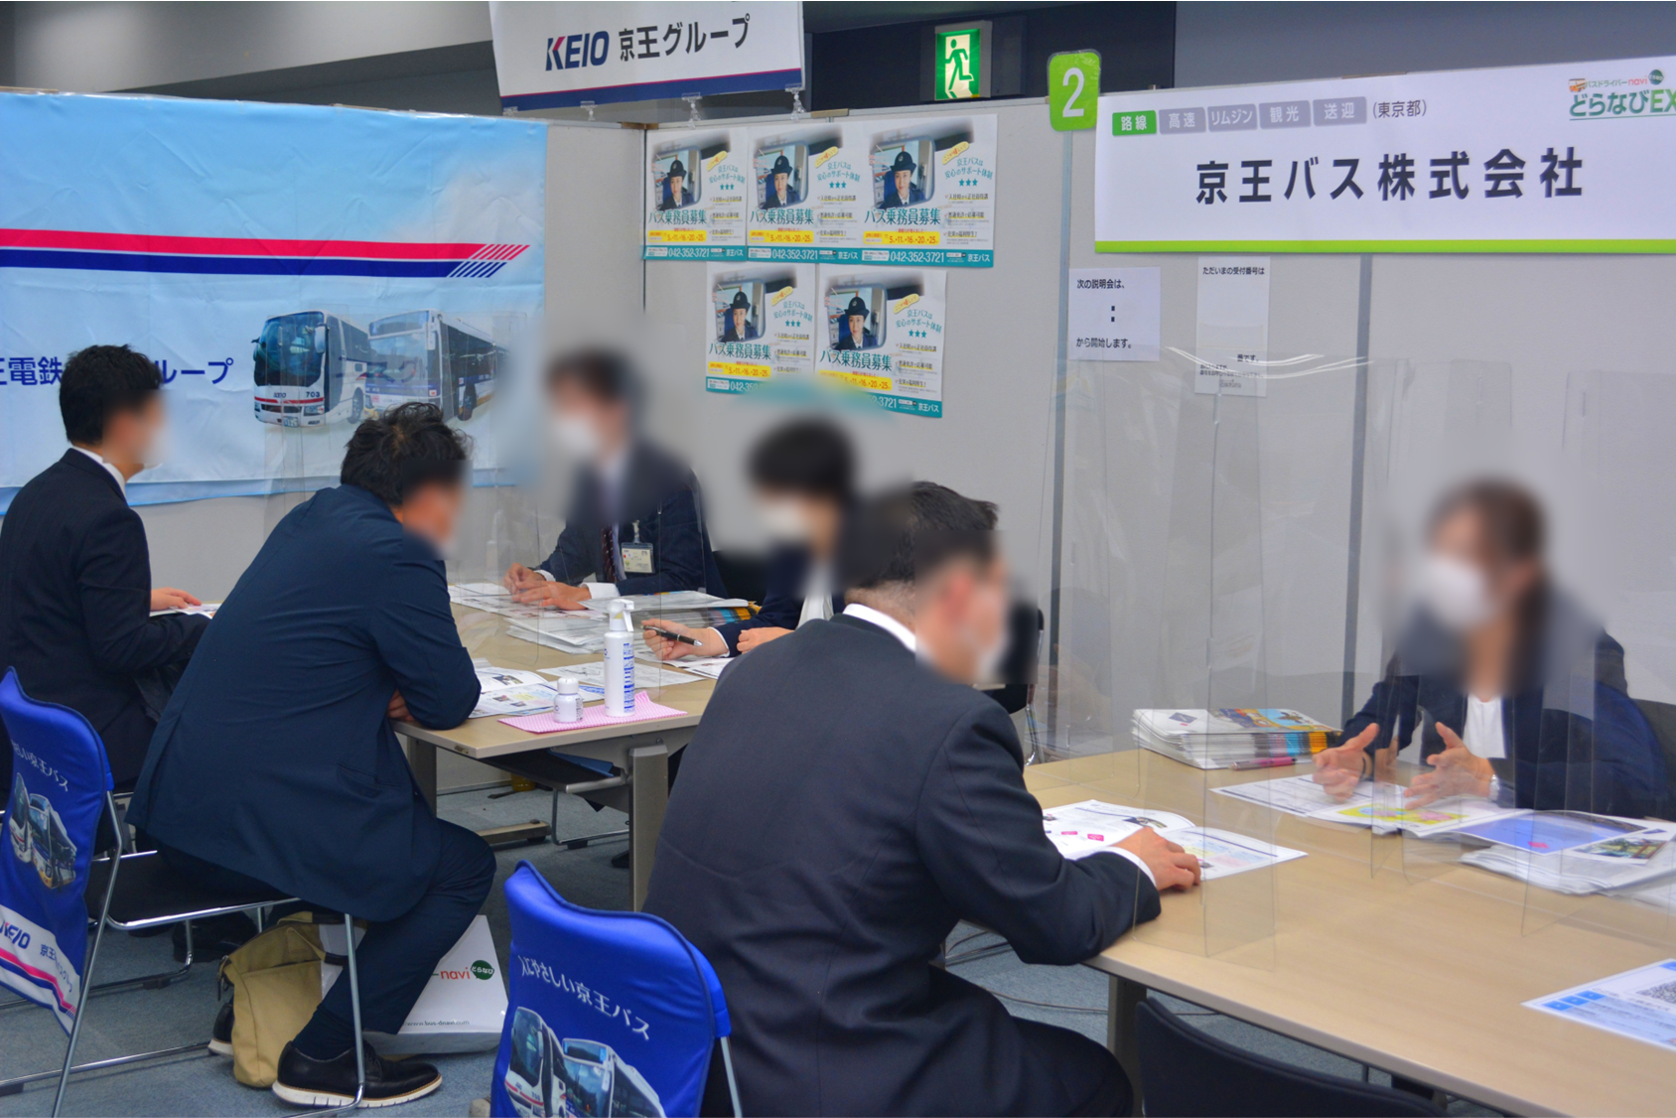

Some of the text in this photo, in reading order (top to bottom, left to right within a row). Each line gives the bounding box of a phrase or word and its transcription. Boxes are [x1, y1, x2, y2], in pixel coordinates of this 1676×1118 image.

[545, 12, 751, 71] KEIO 京王グループ
[1062, 67, 1085, 117] 2
[1120, 115, 1148, 131] 路線
[1168, 112, 1196, 129] 高速
[1211, 108, 1253, 126] リムジン
[1269, 105, 1299, 123] 観光
[1323, 102, 1355, 119] 送迎
[1196, 146, 1583, 204] 京王バス株式会社
[649, 208, 707, 225] バス乗務員募集
[750, 207, 814, 225] バス乗務員募集
[864, 207, 941, 226] バス乗務員募集
[668, 247, 709, 258] 042-352-3721
[773, 248, 818, 260] 042-352-3721
[890, 251, 944, 263] 042-352-3721
[1202, 266, 1265, 276] ただいまの受付番号は
[1076, 279, 1125, 289] 次の説明会は、
[709, 342, 772, 360] バス乗務員募集
[1076, 338, 1132, 349] から開始します。
[820, 349, 892, 372] バス乗務員募集
